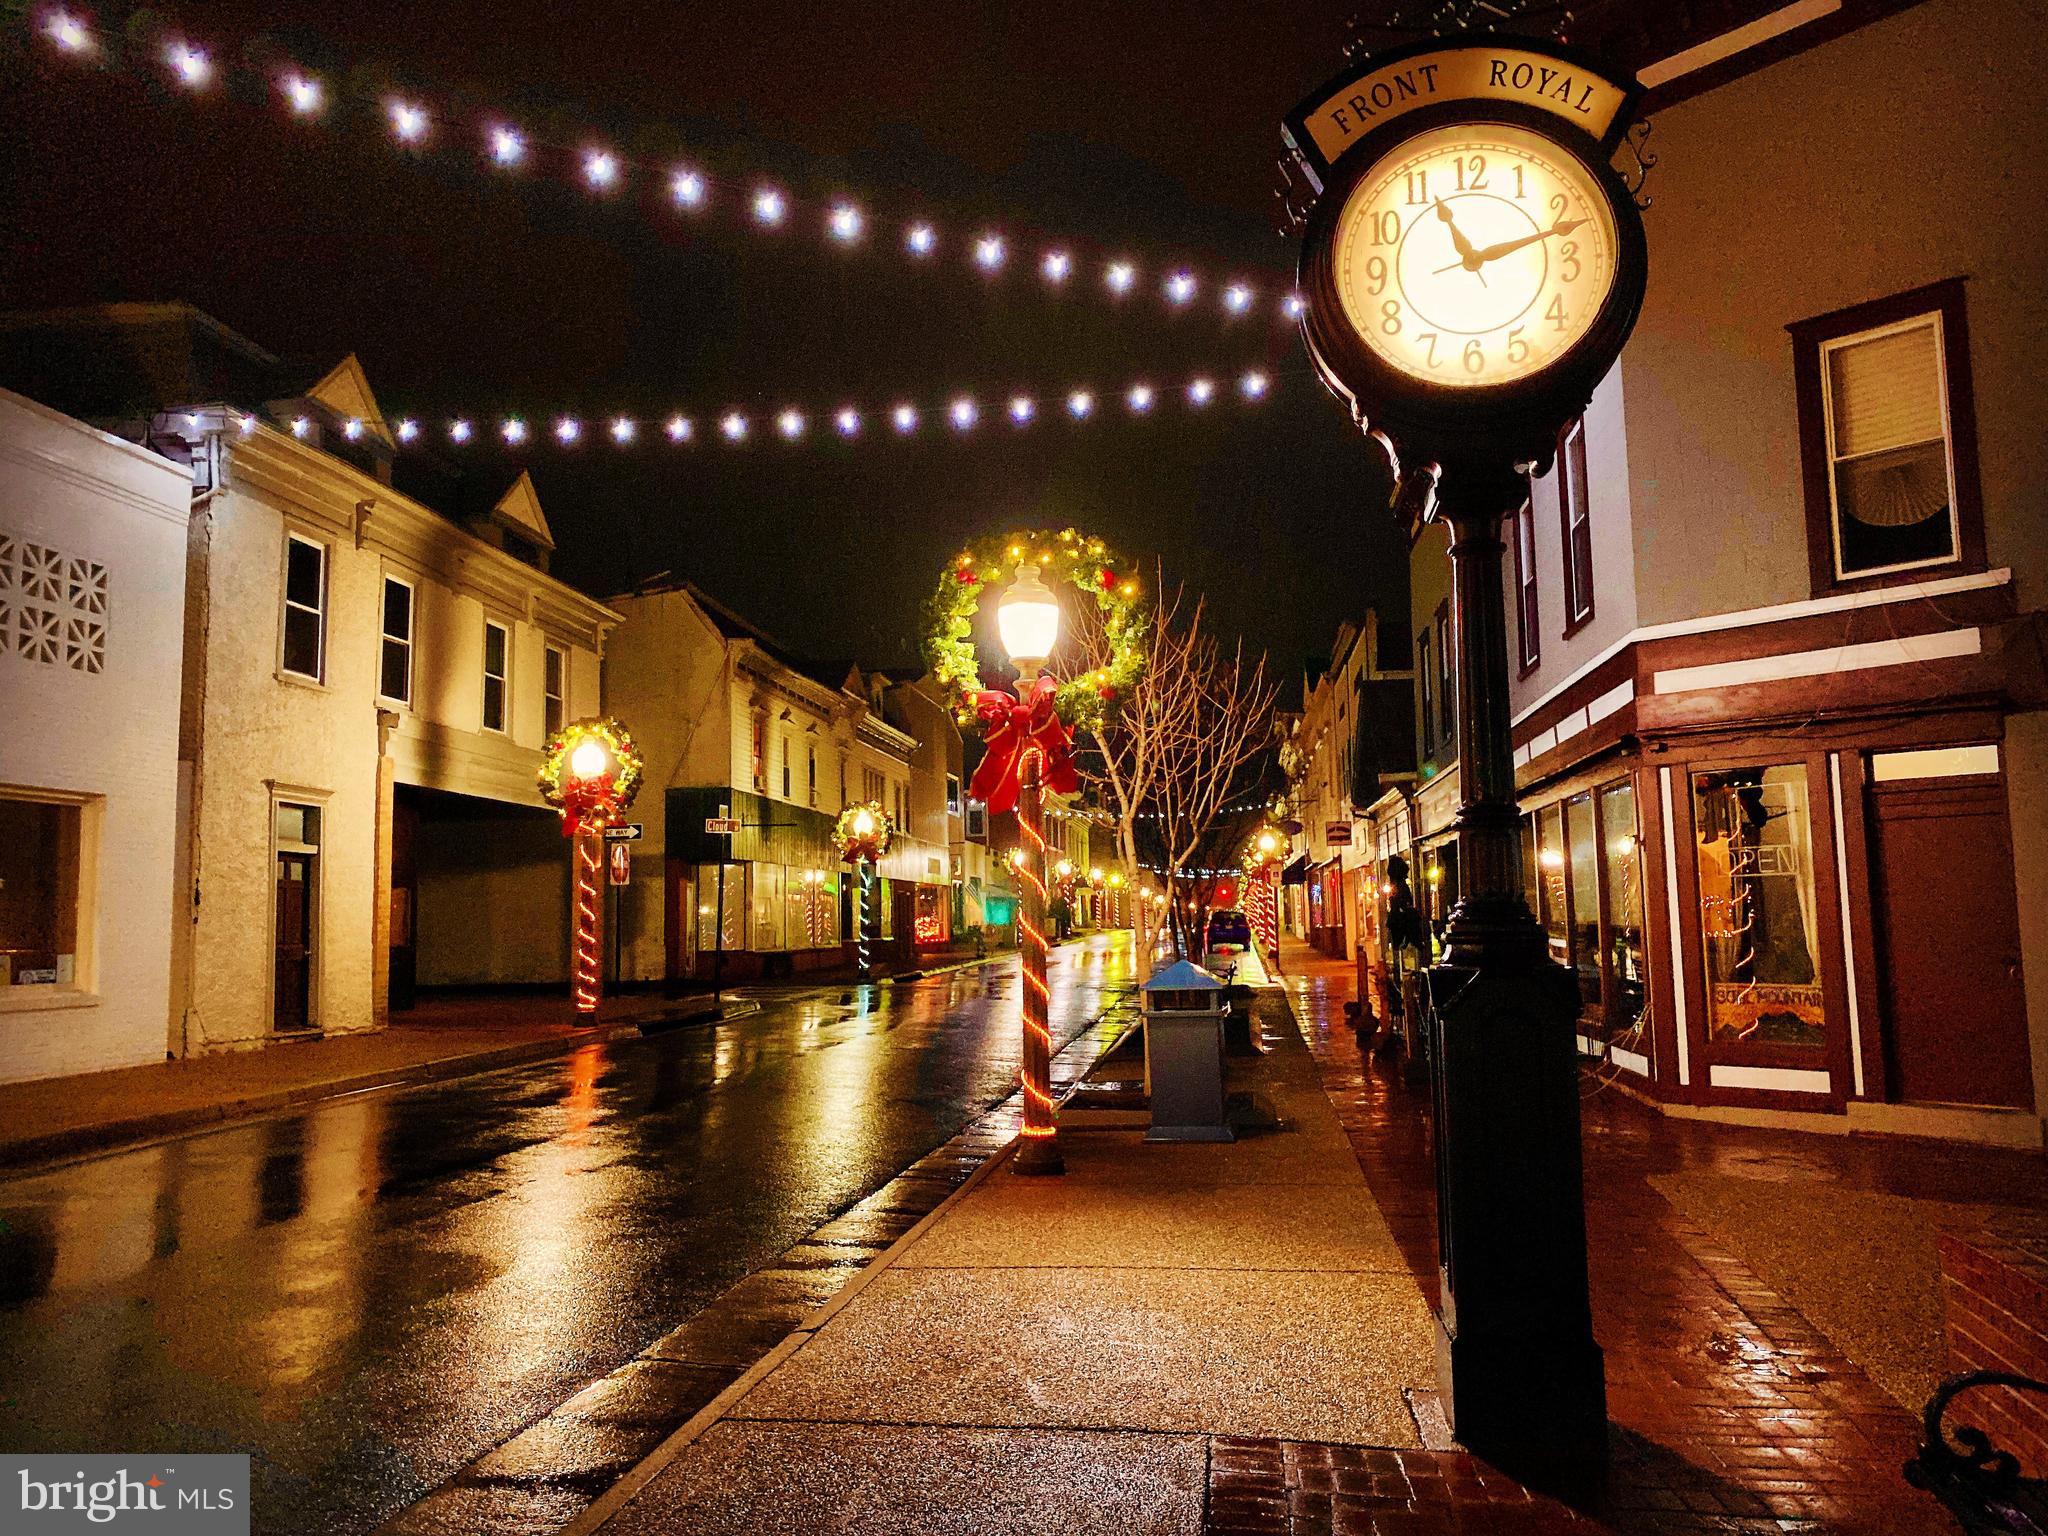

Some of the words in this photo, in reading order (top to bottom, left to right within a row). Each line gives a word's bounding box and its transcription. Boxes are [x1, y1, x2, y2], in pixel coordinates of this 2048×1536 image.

[1330, 64, 1439, 135] FRONT
[1488, 59, 1594, 114] ROYAL
[1404, 170, 1429, 205] 11
[1453, 155, 1489, 192] 12
[1512, 164, 1527, 199] 1
[1550, 193, 1580, 225] 2
[1370, 210, 1401, 246] 10
[1366, 256, 1388, 296] 9
[1560, 241, 1582, 283] 3
[1381, 300, 1402, 336] 8
[1545, 293, 1569, 332] 4
[1415, 333, 1443, 369] 7
[1463, 340, 1485, 375] 6
[1508, 326, 1529, 364] 5
[708, 821, 728, 831] Cloud
[1719, 847, 1795, 874] OPEN
